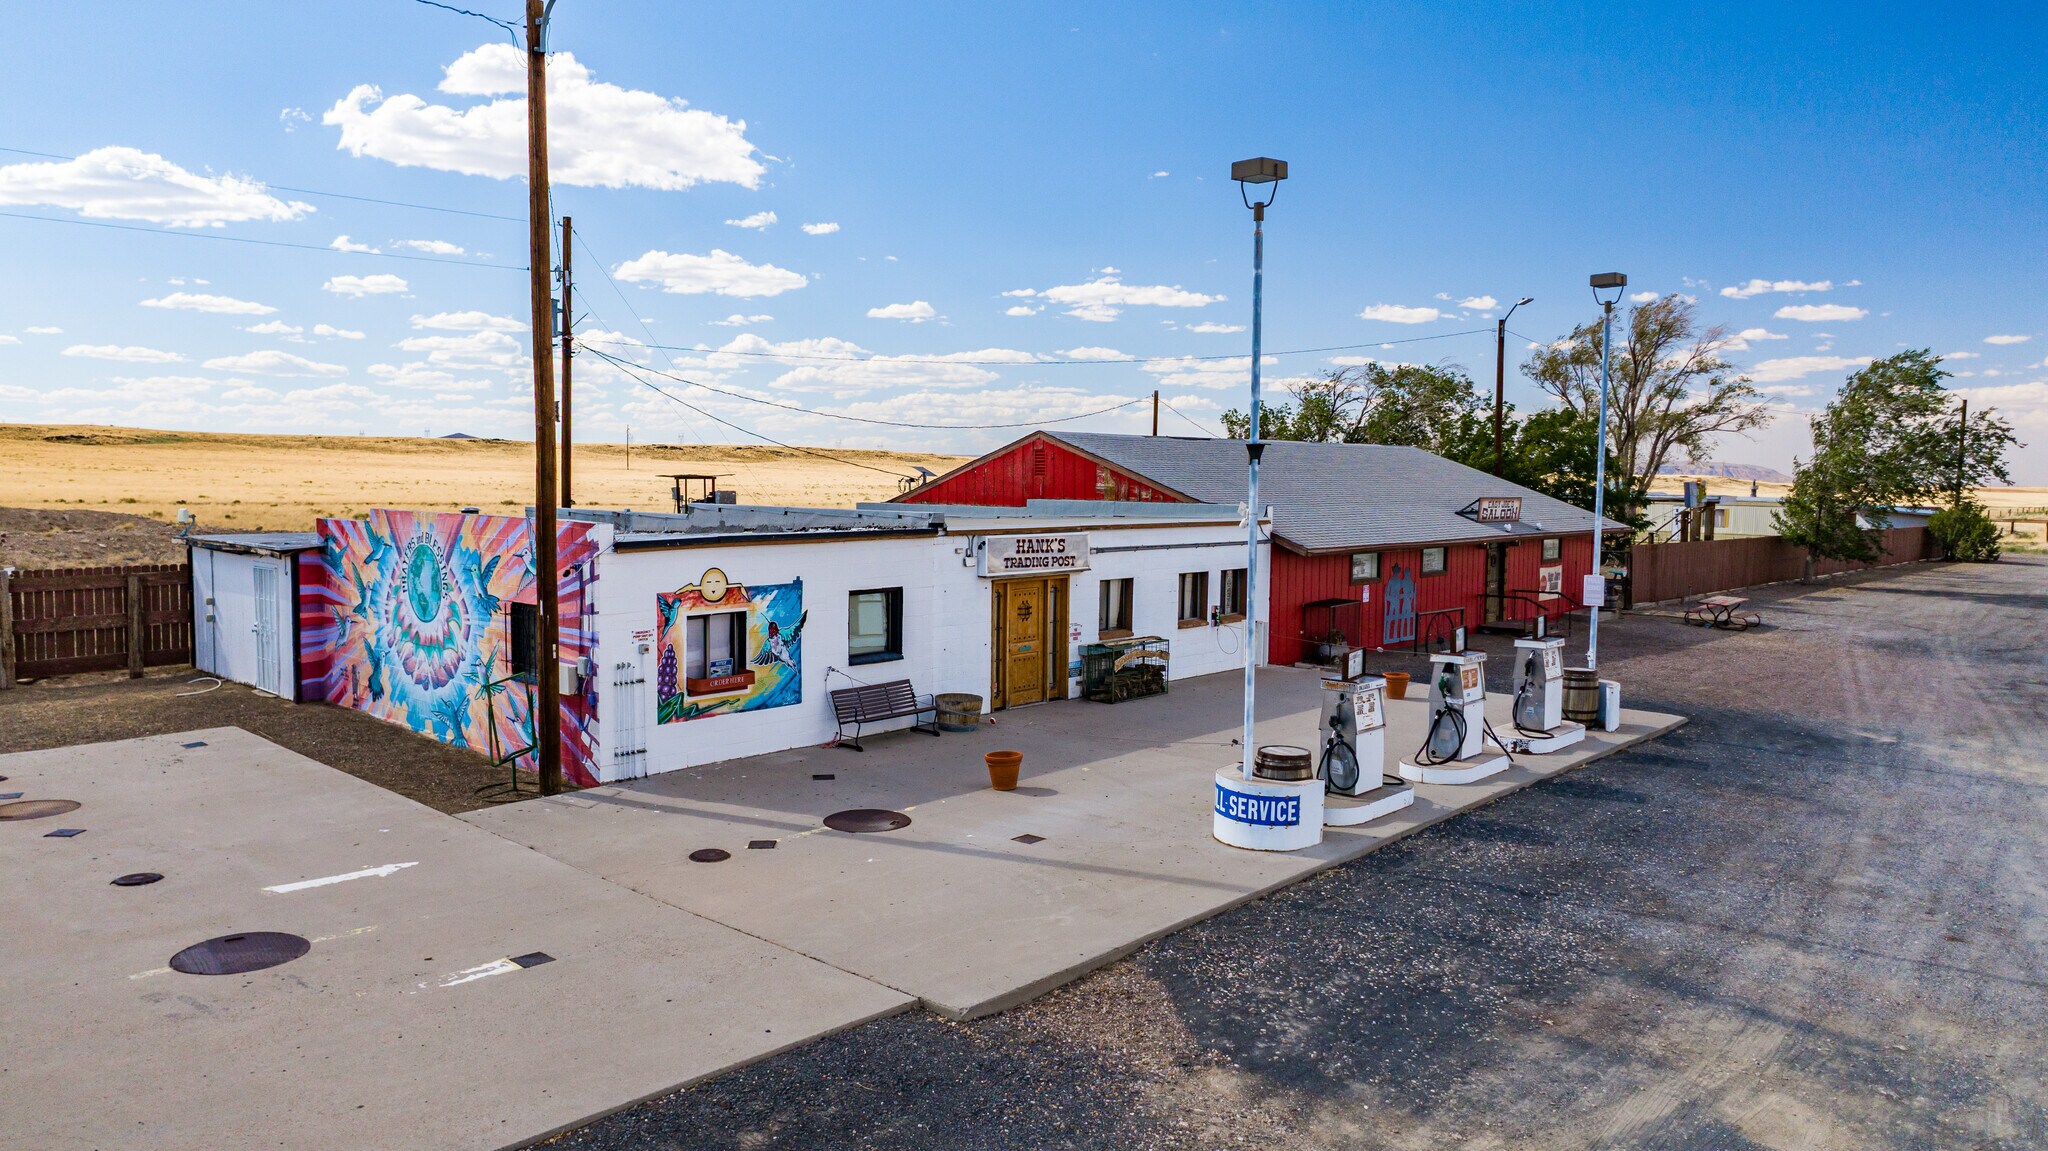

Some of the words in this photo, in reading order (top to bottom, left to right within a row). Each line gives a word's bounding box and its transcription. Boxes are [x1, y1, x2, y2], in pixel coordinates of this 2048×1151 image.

[1481, 507, 1518, 520] SALOON
[1015, 538, 1066, 554] HANK'S
[401, 537, 416, 593] PRAYERS
[424, 531, 449, 601] BLESSINGS
[1004, 556, 1049, 568] TRADING
[1051, 556, 1076, 567] POST
[710, 678, 730, 687] ORDER
[730, 676, 745, 684] HERE
